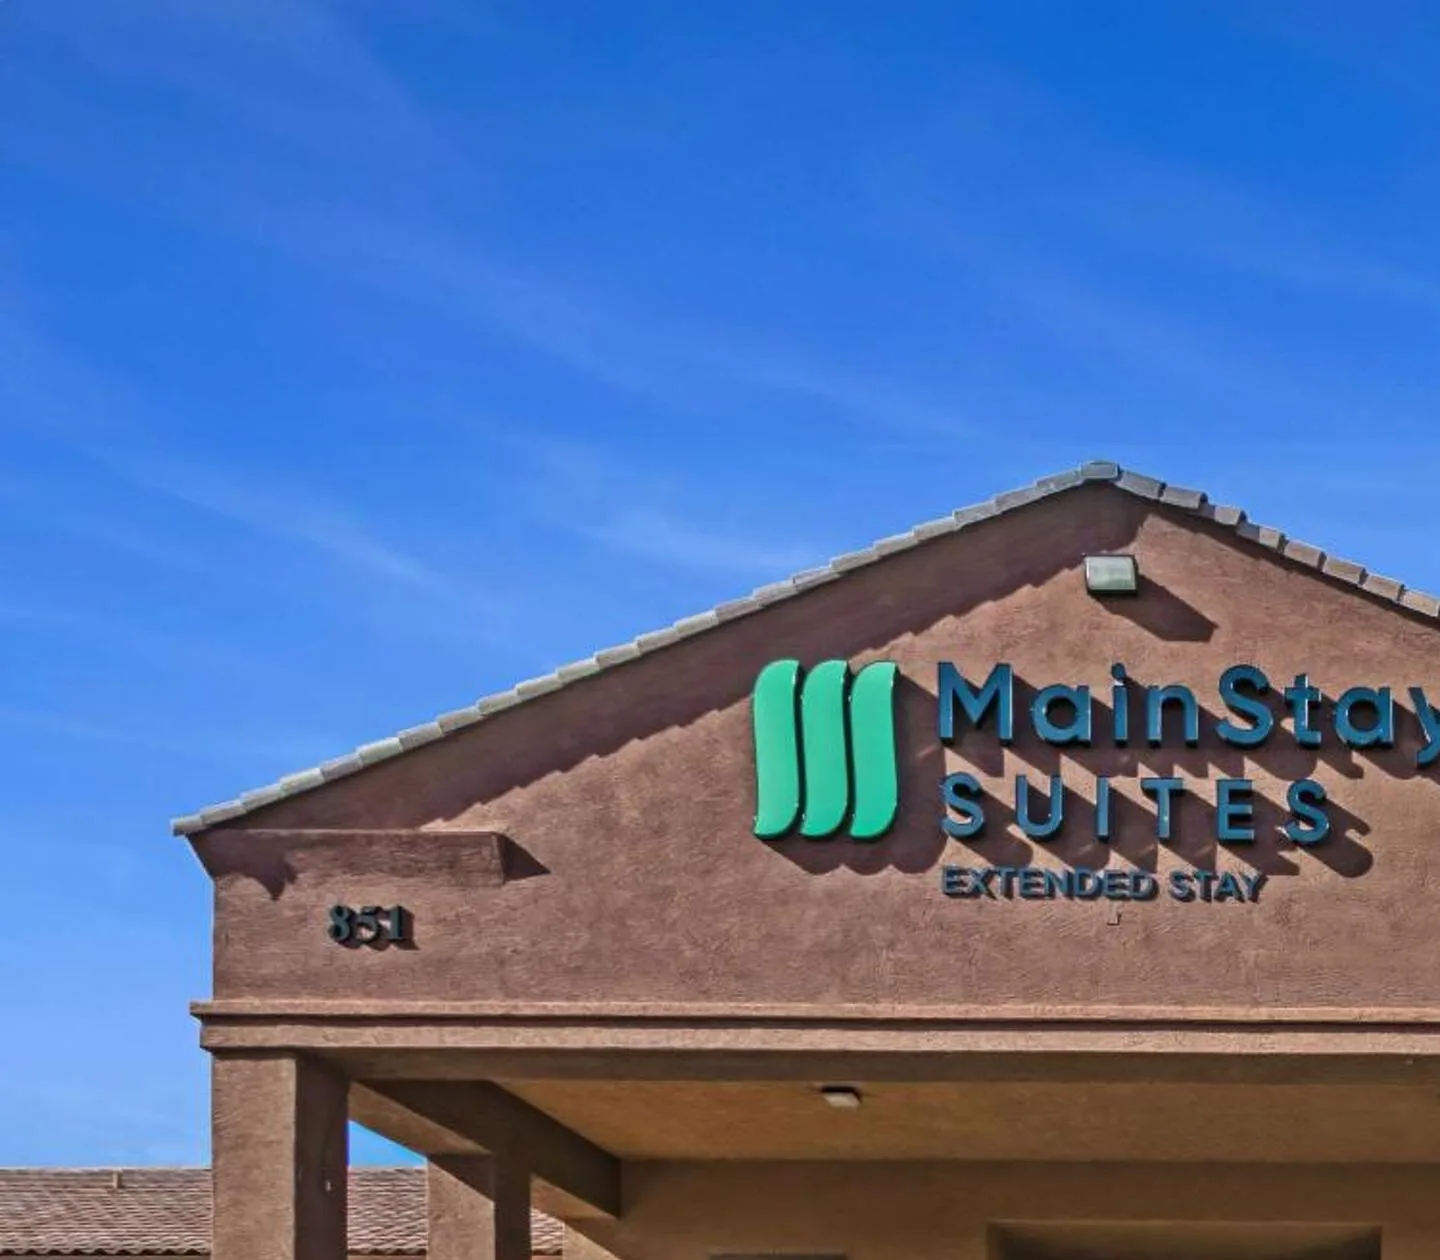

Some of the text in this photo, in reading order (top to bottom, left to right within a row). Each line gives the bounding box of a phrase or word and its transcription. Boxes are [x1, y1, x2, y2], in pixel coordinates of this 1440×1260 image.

[939, 770, 1332, 845] SUITES
[942, 865, 1267, 902] EXTENDED STAY
[327, 904, 404, 943] 851
